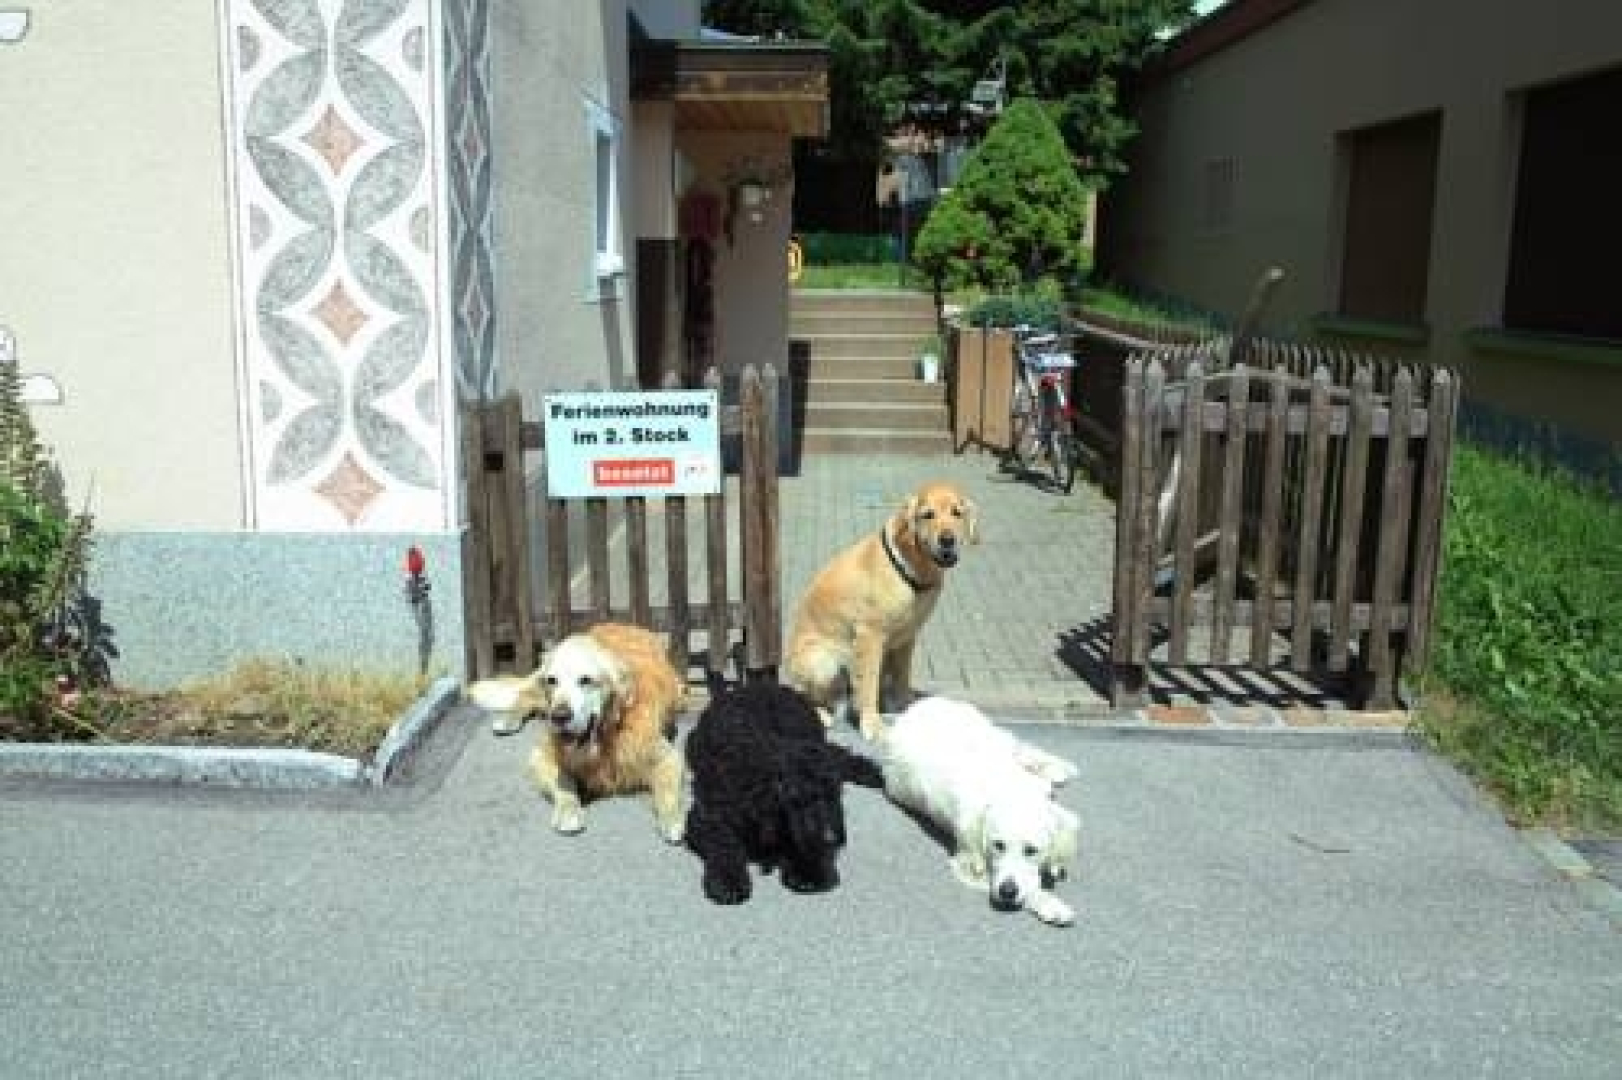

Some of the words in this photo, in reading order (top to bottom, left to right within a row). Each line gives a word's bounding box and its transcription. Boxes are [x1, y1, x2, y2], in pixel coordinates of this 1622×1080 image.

[551, 402, 709, 419] Ferienwohnung
[573, 428, 598, 445] im
[605, 427, 624, 445] 2.
[631, 426, 690, 443] Stock
